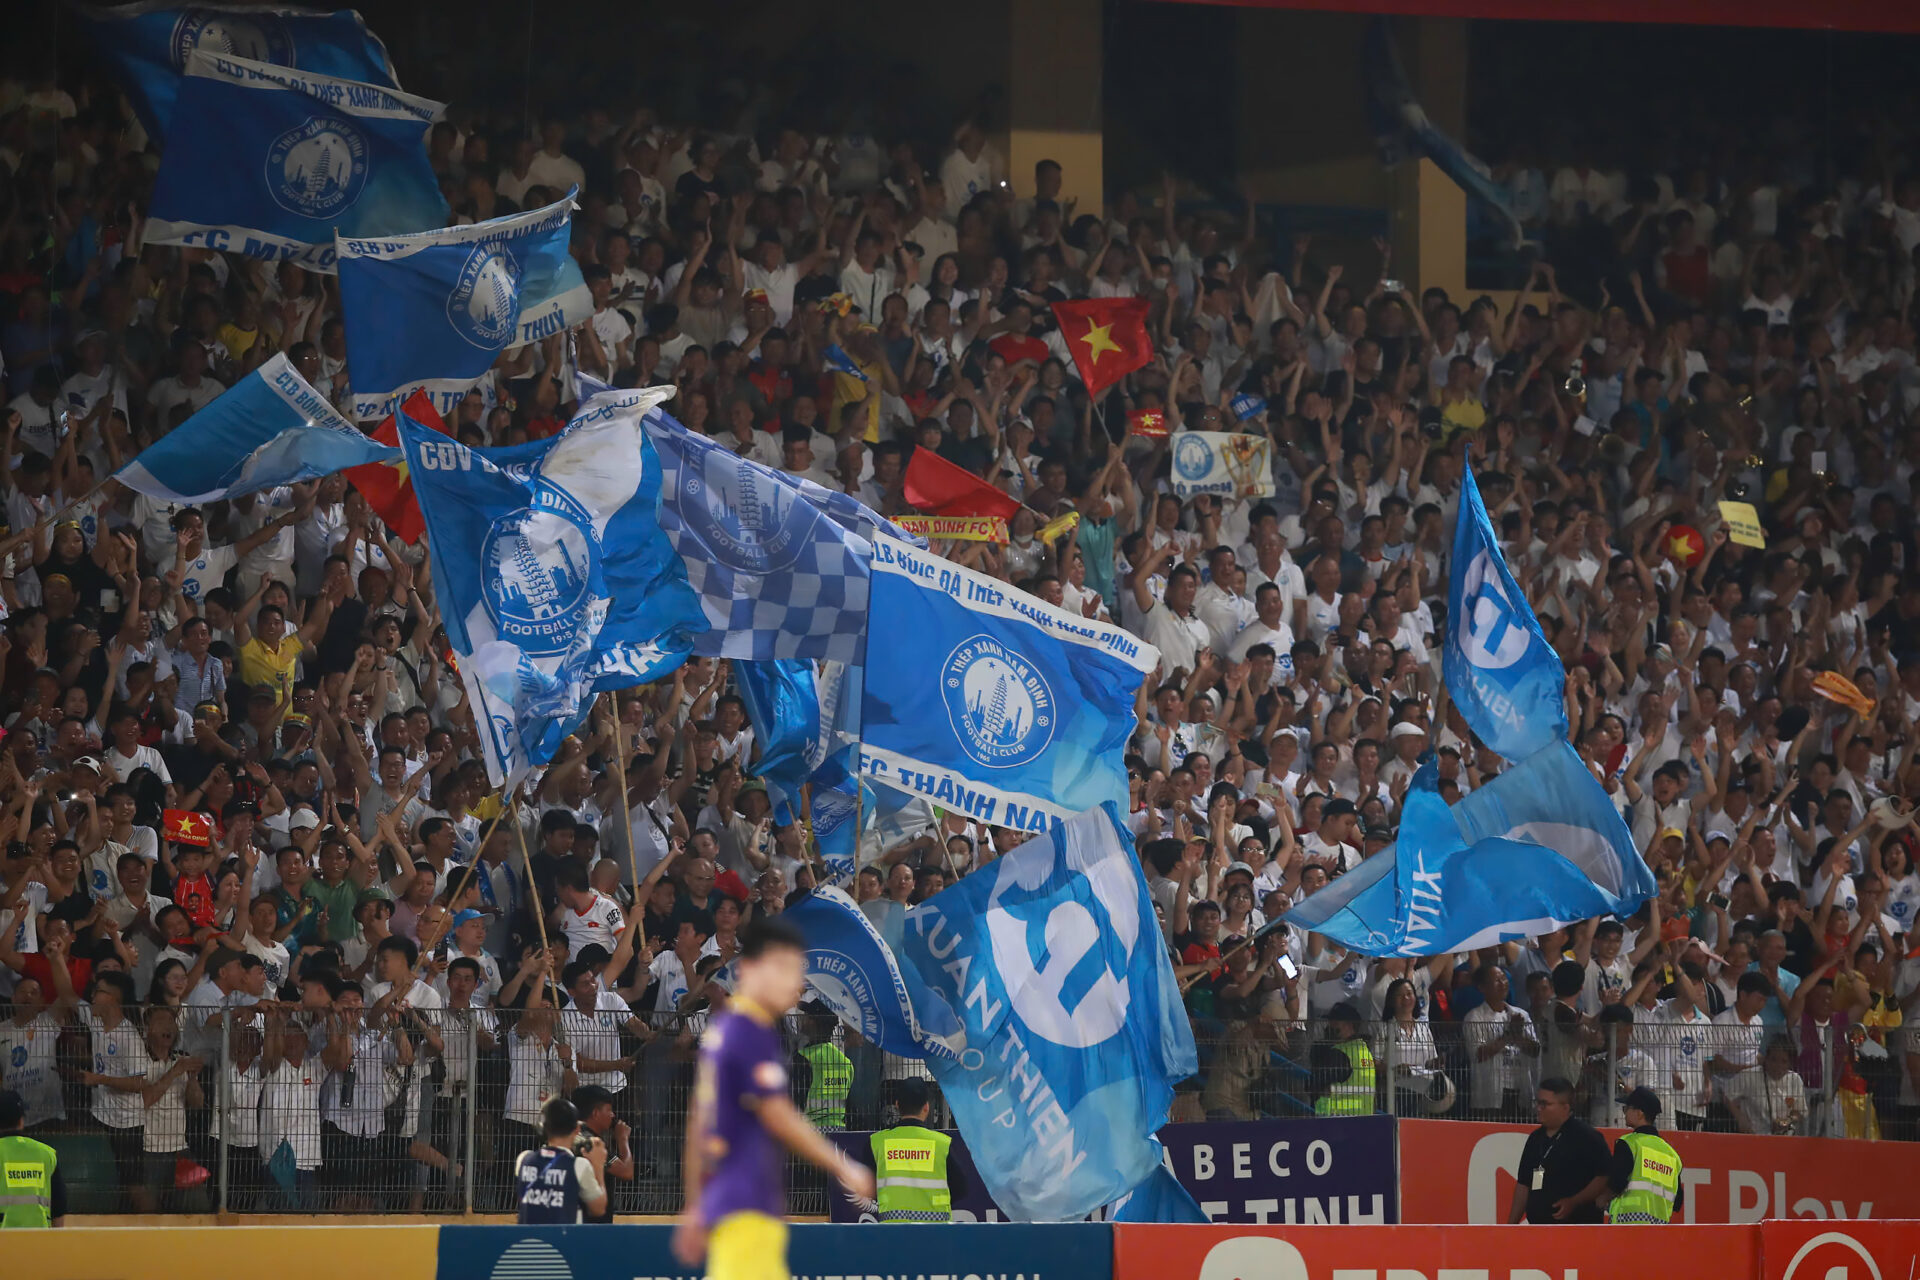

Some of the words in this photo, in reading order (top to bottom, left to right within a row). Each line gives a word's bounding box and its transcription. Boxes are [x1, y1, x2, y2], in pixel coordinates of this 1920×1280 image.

[346, 86, 381, 109] XANH
[275, 371, 300, 397] CLB
[295, 390, 329, 421] BÓNG
[420, 441, 472, 472] CĐV
[706, 524, 769, 559] FOOTBALL
[768, 529, 793, 555] CLUB
[900, 520, 931, 535] NAM
[968, 521, 990, 536] FC
[938, 569, 962, 598] ĐÁ
[966, 577, 1005, 607] THÉP
[502, 617, 574, 637] FOOTBALL
[950, 647, 974, 674] THÉP
[973, 640, 1004, 658] XANH
[1004, 652, 1030, 680] NAM
[1026, 676, 1050, 709] ĐỊNH
[960, 713, 999, 758] FOOTBALL
[999, 743, 1027, 758] CLUB
[859, 753, 889, 777] FC
[1397, 847, 1443, 957] XUAN
[899, 904, 1003, 1033] XUAN
[816, 955, 847, 974] THÉP
[844, 969, 870, 1008] XANH
[862, 1005, 878, 1035] NAM
[999, 1021, 1088, 1181] THIEN
[886, 1149, 932, 1161] SECURITY
[1643, 1158, 1674, 1177] SECURITY
